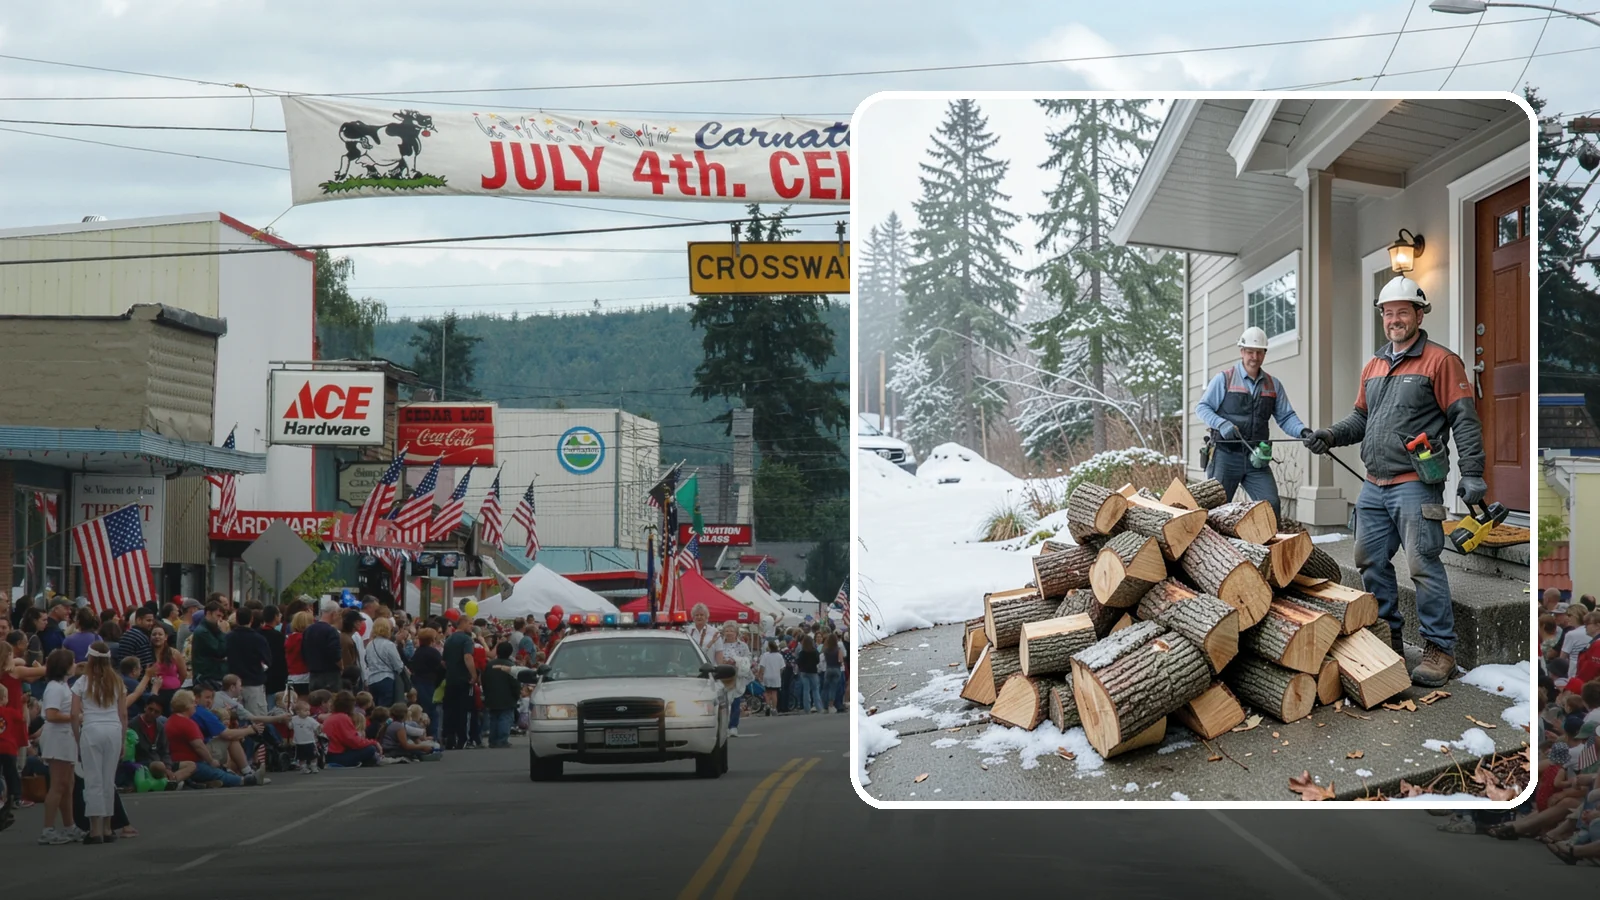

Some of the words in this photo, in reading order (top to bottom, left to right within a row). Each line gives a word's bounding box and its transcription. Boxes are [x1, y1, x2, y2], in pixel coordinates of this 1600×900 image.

[695, 121, 850, 150] Carnat
[481, 141, 604, 192] JULY
[632, 150, 746, 198] 4th.
[696, 254, 850, 280] CROSSWA
[283, 380, 374, 420] ACE
[405, 409, 453, 421] CEDAR
[461, 409, 485, 421] LOG
[283, 421, 371, 437] Hardware
[416, 428, 478, 446] Coca-Cola
[353, 466, 385, 480] Simpl
[83, 485, 93, 494] St.
[96, 486, 124, 495] Vincent
[126, 486, 135, 495] de
[138, 486, 155, 496] Paul
[699, 535, 730, 543] GLASS
